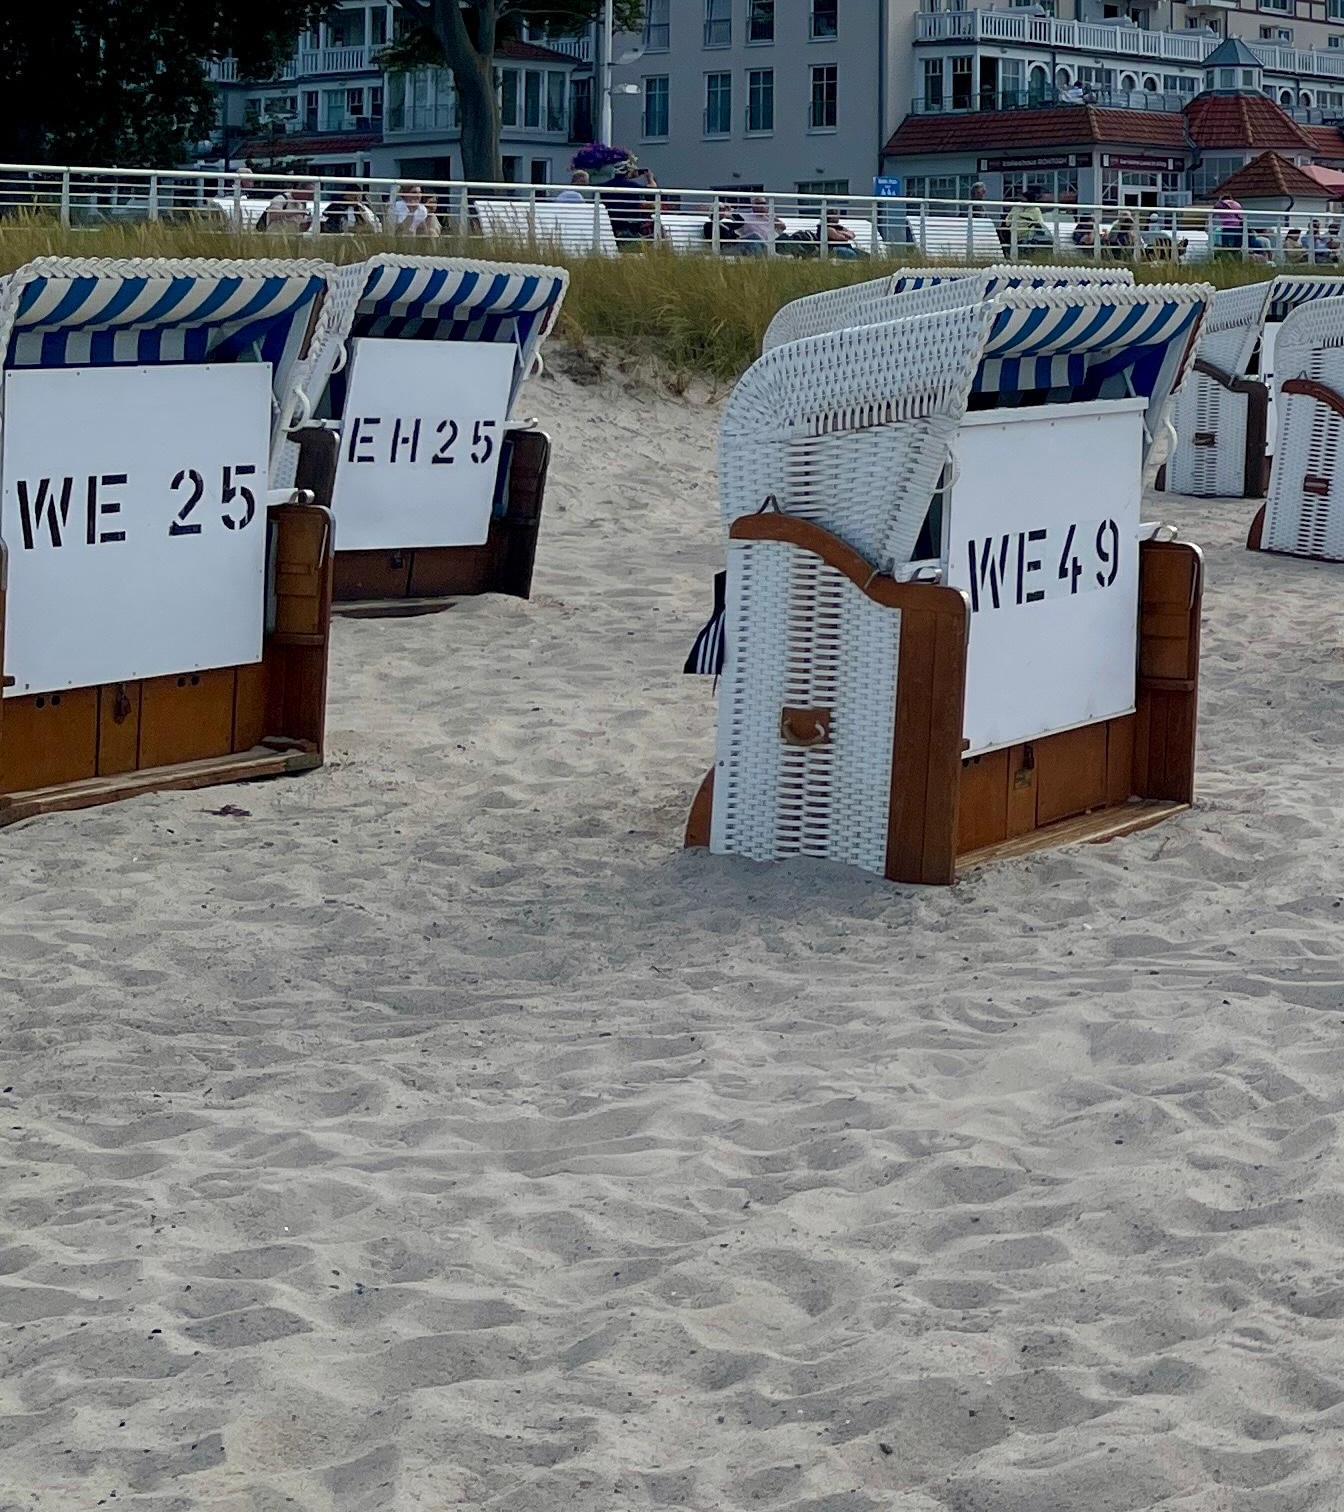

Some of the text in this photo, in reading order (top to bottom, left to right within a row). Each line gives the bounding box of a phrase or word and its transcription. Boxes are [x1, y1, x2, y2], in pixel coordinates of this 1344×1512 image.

[348, 417, 496, 465] EH25
[16, 464, 257, 550] WE 25
[968, 518, 1120, 613] WE49
